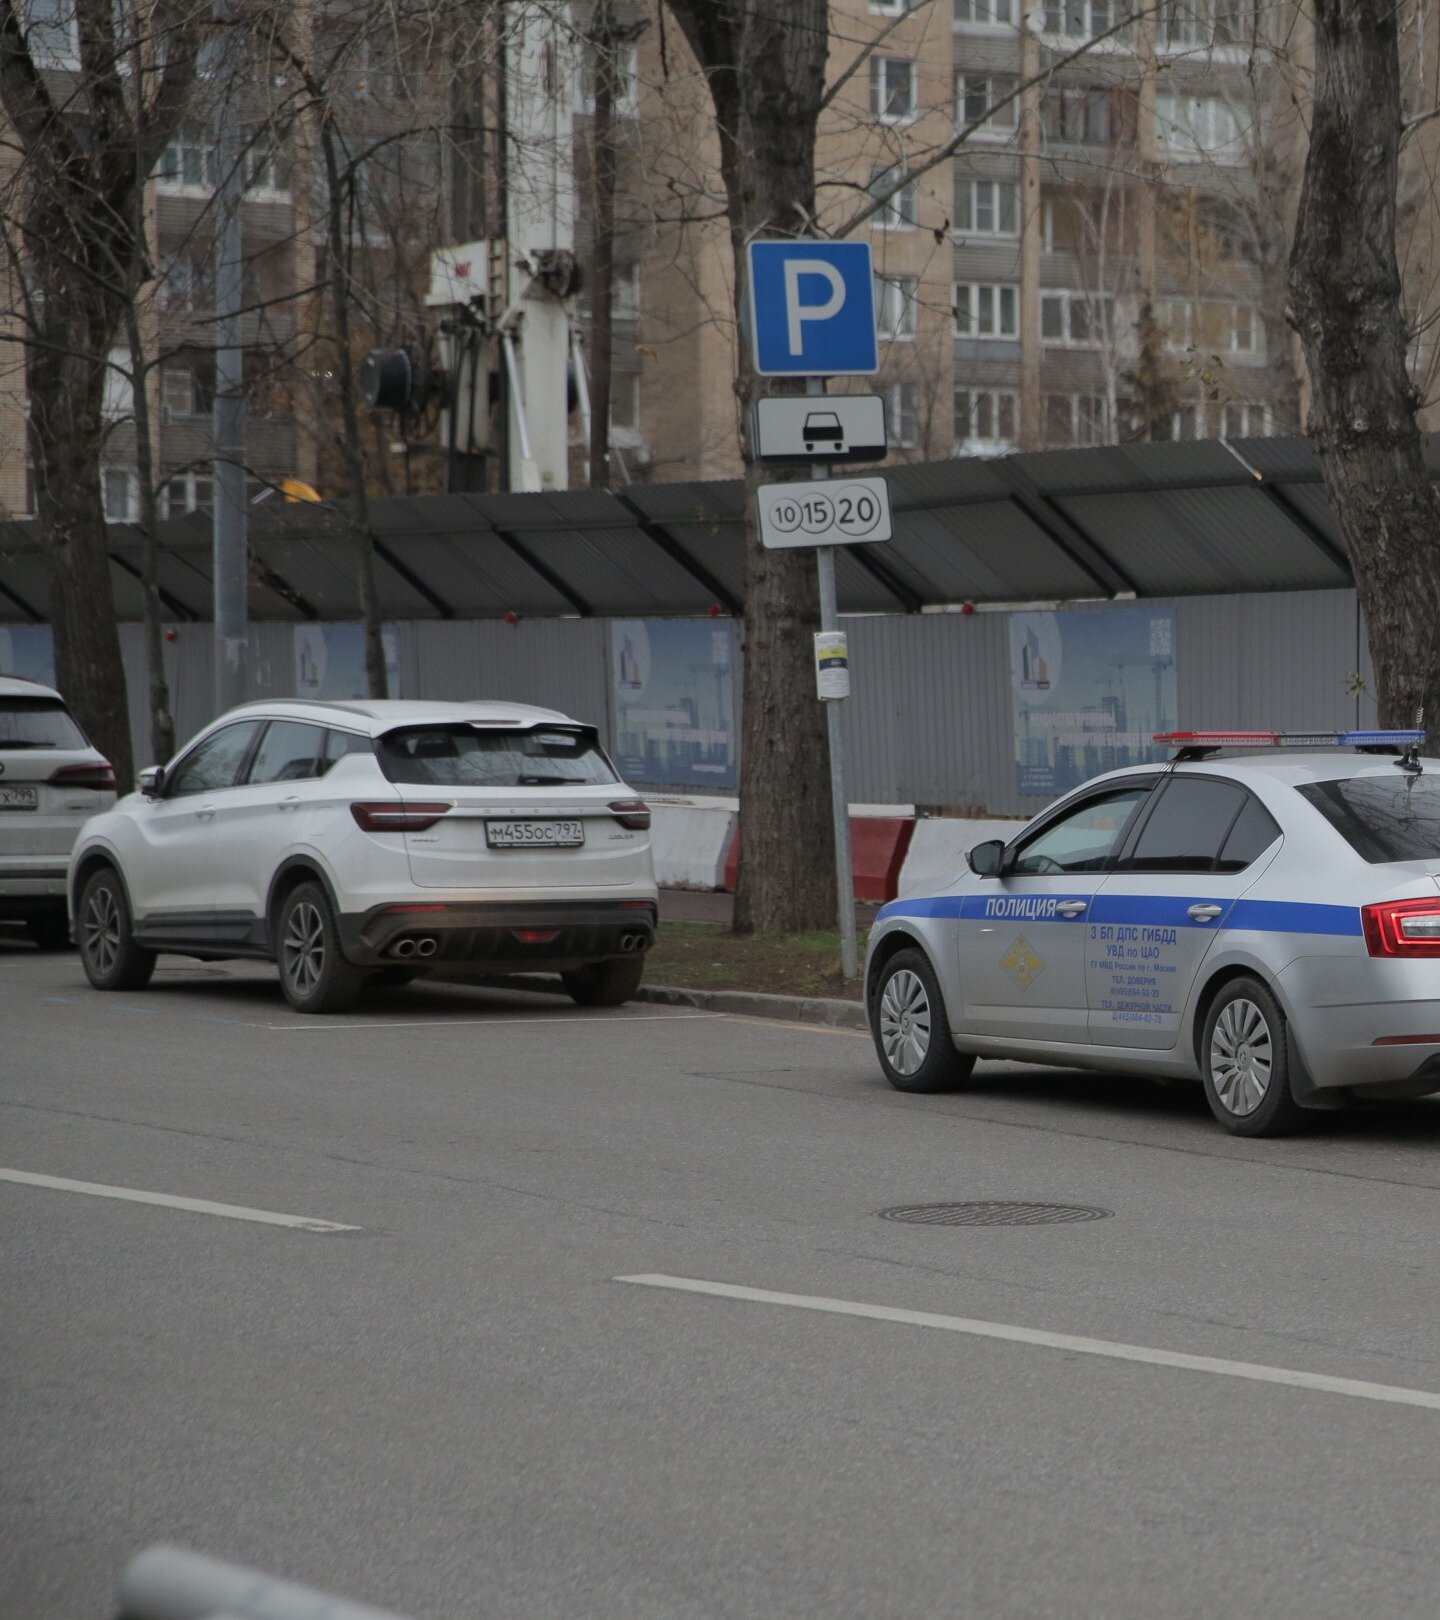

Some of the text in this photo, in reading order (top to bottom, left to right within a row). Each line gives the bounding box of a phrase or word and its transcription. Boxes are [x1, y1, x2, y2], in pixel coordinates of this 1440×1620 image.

[783, 258, 846, 356] P
[775, 497, 874, 524] 10 15 20
[493, 823, 578, 840] М455ОС 797
[986, 898, 1057, 920] ПОЛИЦИЯ
[1091, 926, 1176, 945] 3 БП ДПС ГИБДД
[1107, 945, 1160, 960] УВД по ЦАО
[1098, 961, 1113, 970] МВД
